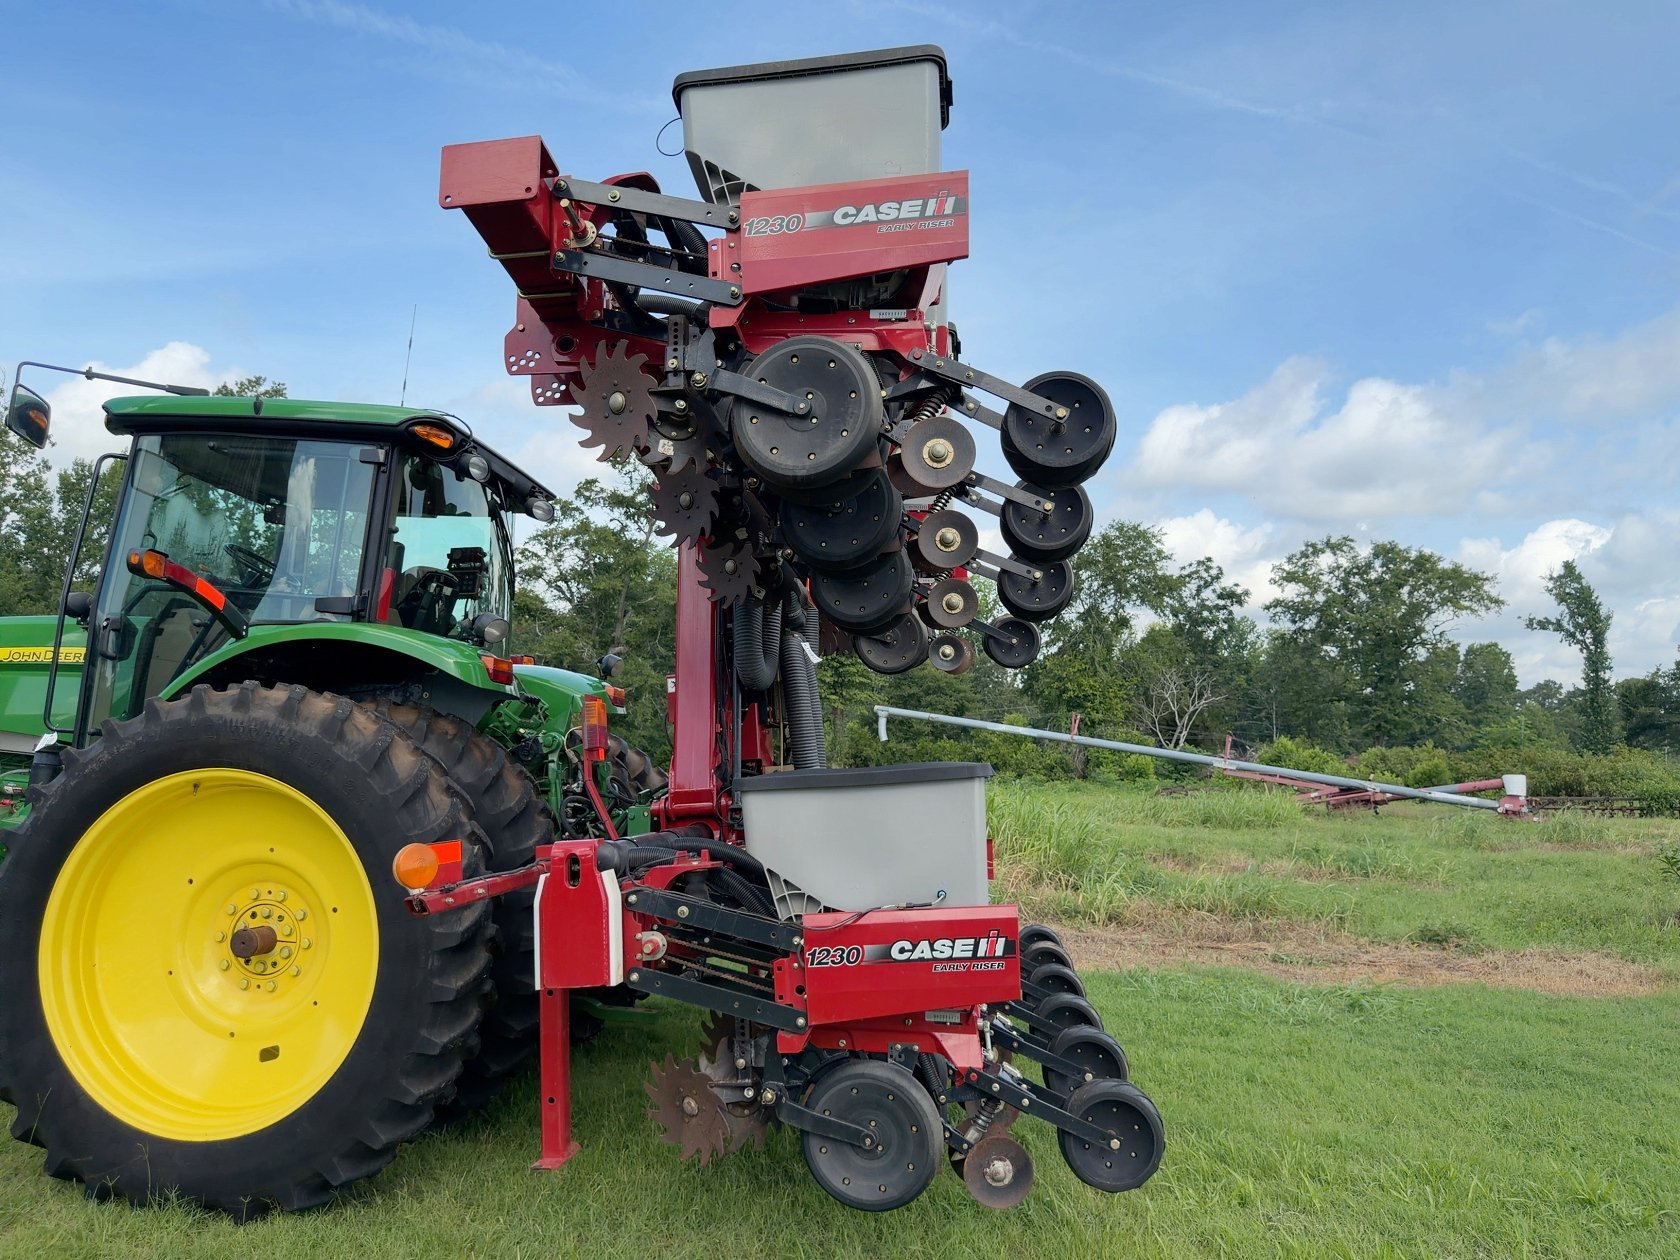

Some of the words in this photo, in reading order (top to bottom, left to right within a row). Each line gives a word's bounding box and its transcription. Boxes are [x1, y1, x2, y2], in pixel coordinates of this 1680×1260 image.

[743, 214, 803, 237] 1230
[833, 200, 922, 225] CASE
[877, 223, 915, 233] EARLY
[918, 219, 954, 230] RISER
[3, 650, 41, 660] JOHN
[44, 650, 86, 660] DEER
[806, 946, 862, 967] 1230
[890, 939, 974, 960] CASE
[932, 963, 968, 972] EARLY
[971, 962, 1004, 971] RISER
